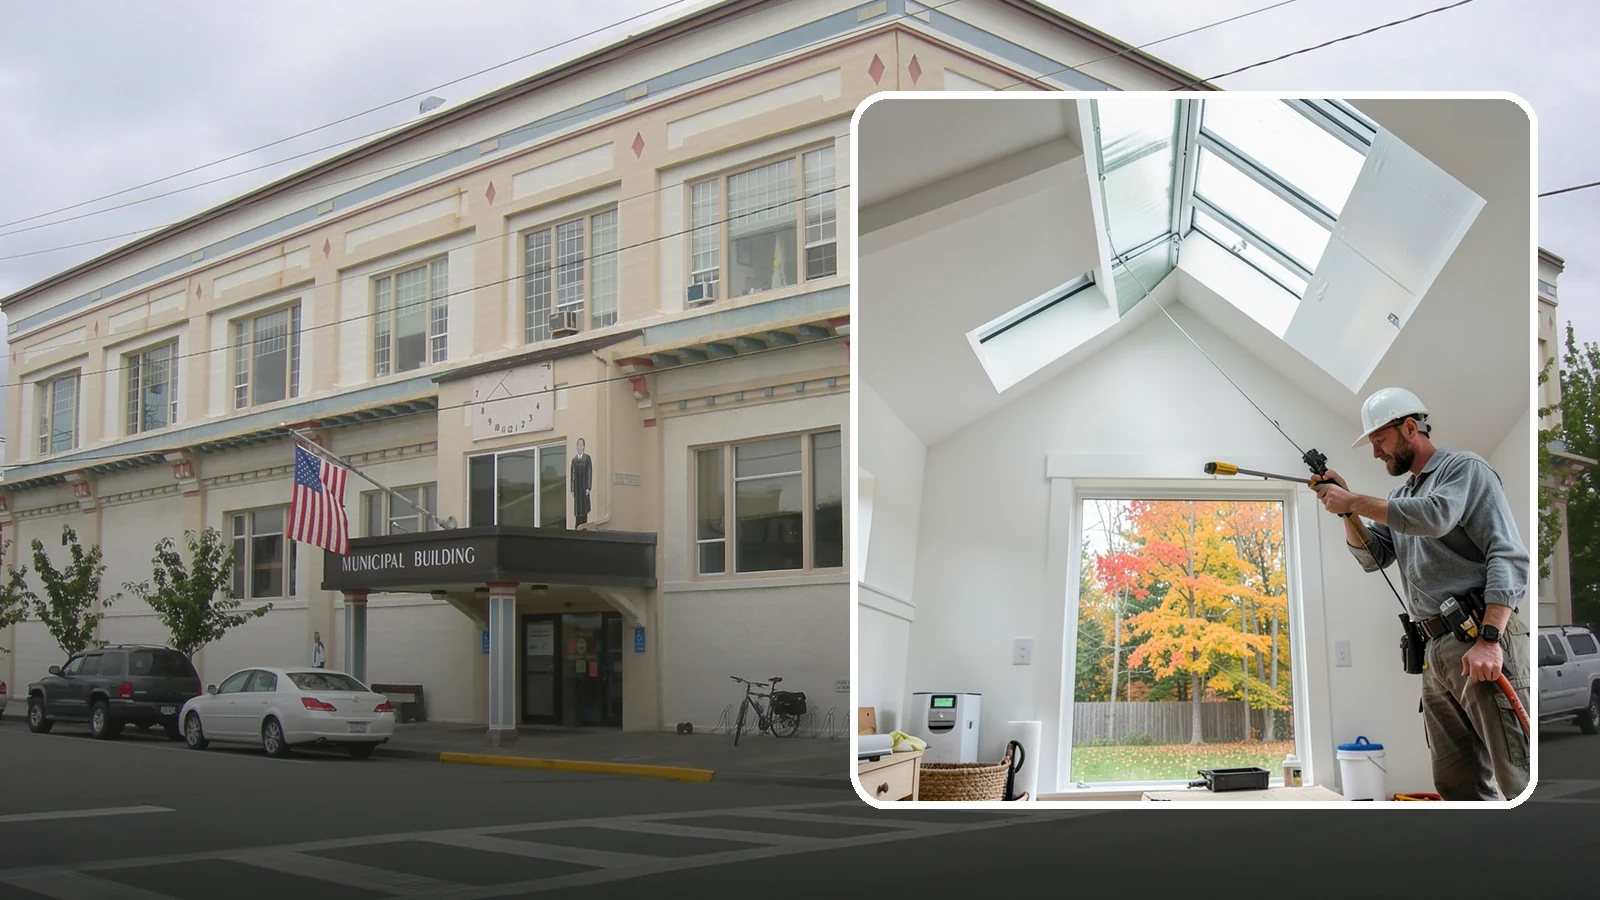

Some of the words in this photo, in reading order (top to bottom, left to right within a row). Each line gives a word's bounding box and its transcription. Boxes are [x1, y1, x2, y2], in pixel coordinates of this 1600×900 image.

[529, 414, 533, 422] 3
[494, 424, 500, 432] 10
[342, 552, 405, 572] MUNICIPAL
[414, 546, 475, 567] BUILDING
